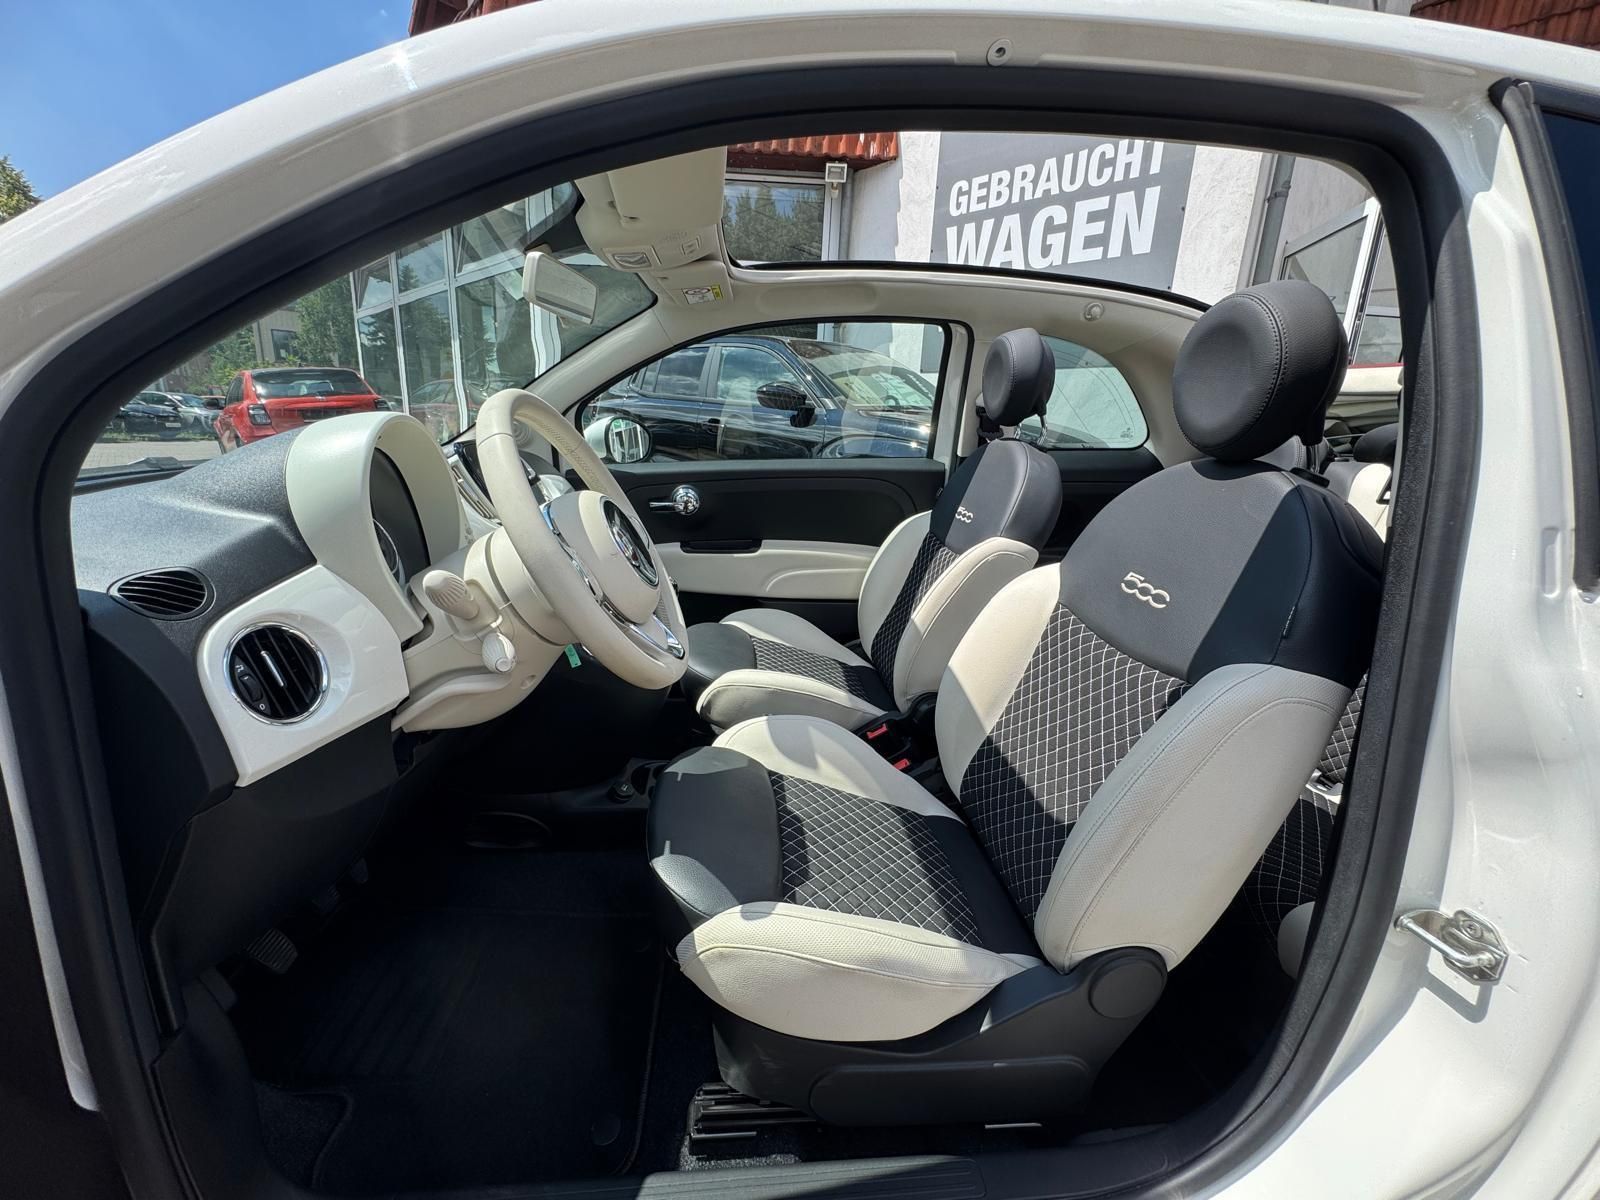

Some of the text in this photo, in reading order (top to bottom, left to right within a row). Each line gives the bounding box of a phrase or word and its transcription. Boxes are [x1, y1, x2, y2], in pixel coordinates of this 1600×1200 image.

[949, 139, 1164, 217] GEBRAUCHT
[946, 186, 1161, 270] WAGEN
[955, 506, 974, 523] 500
[1120, 571, 1170, 609] 500
